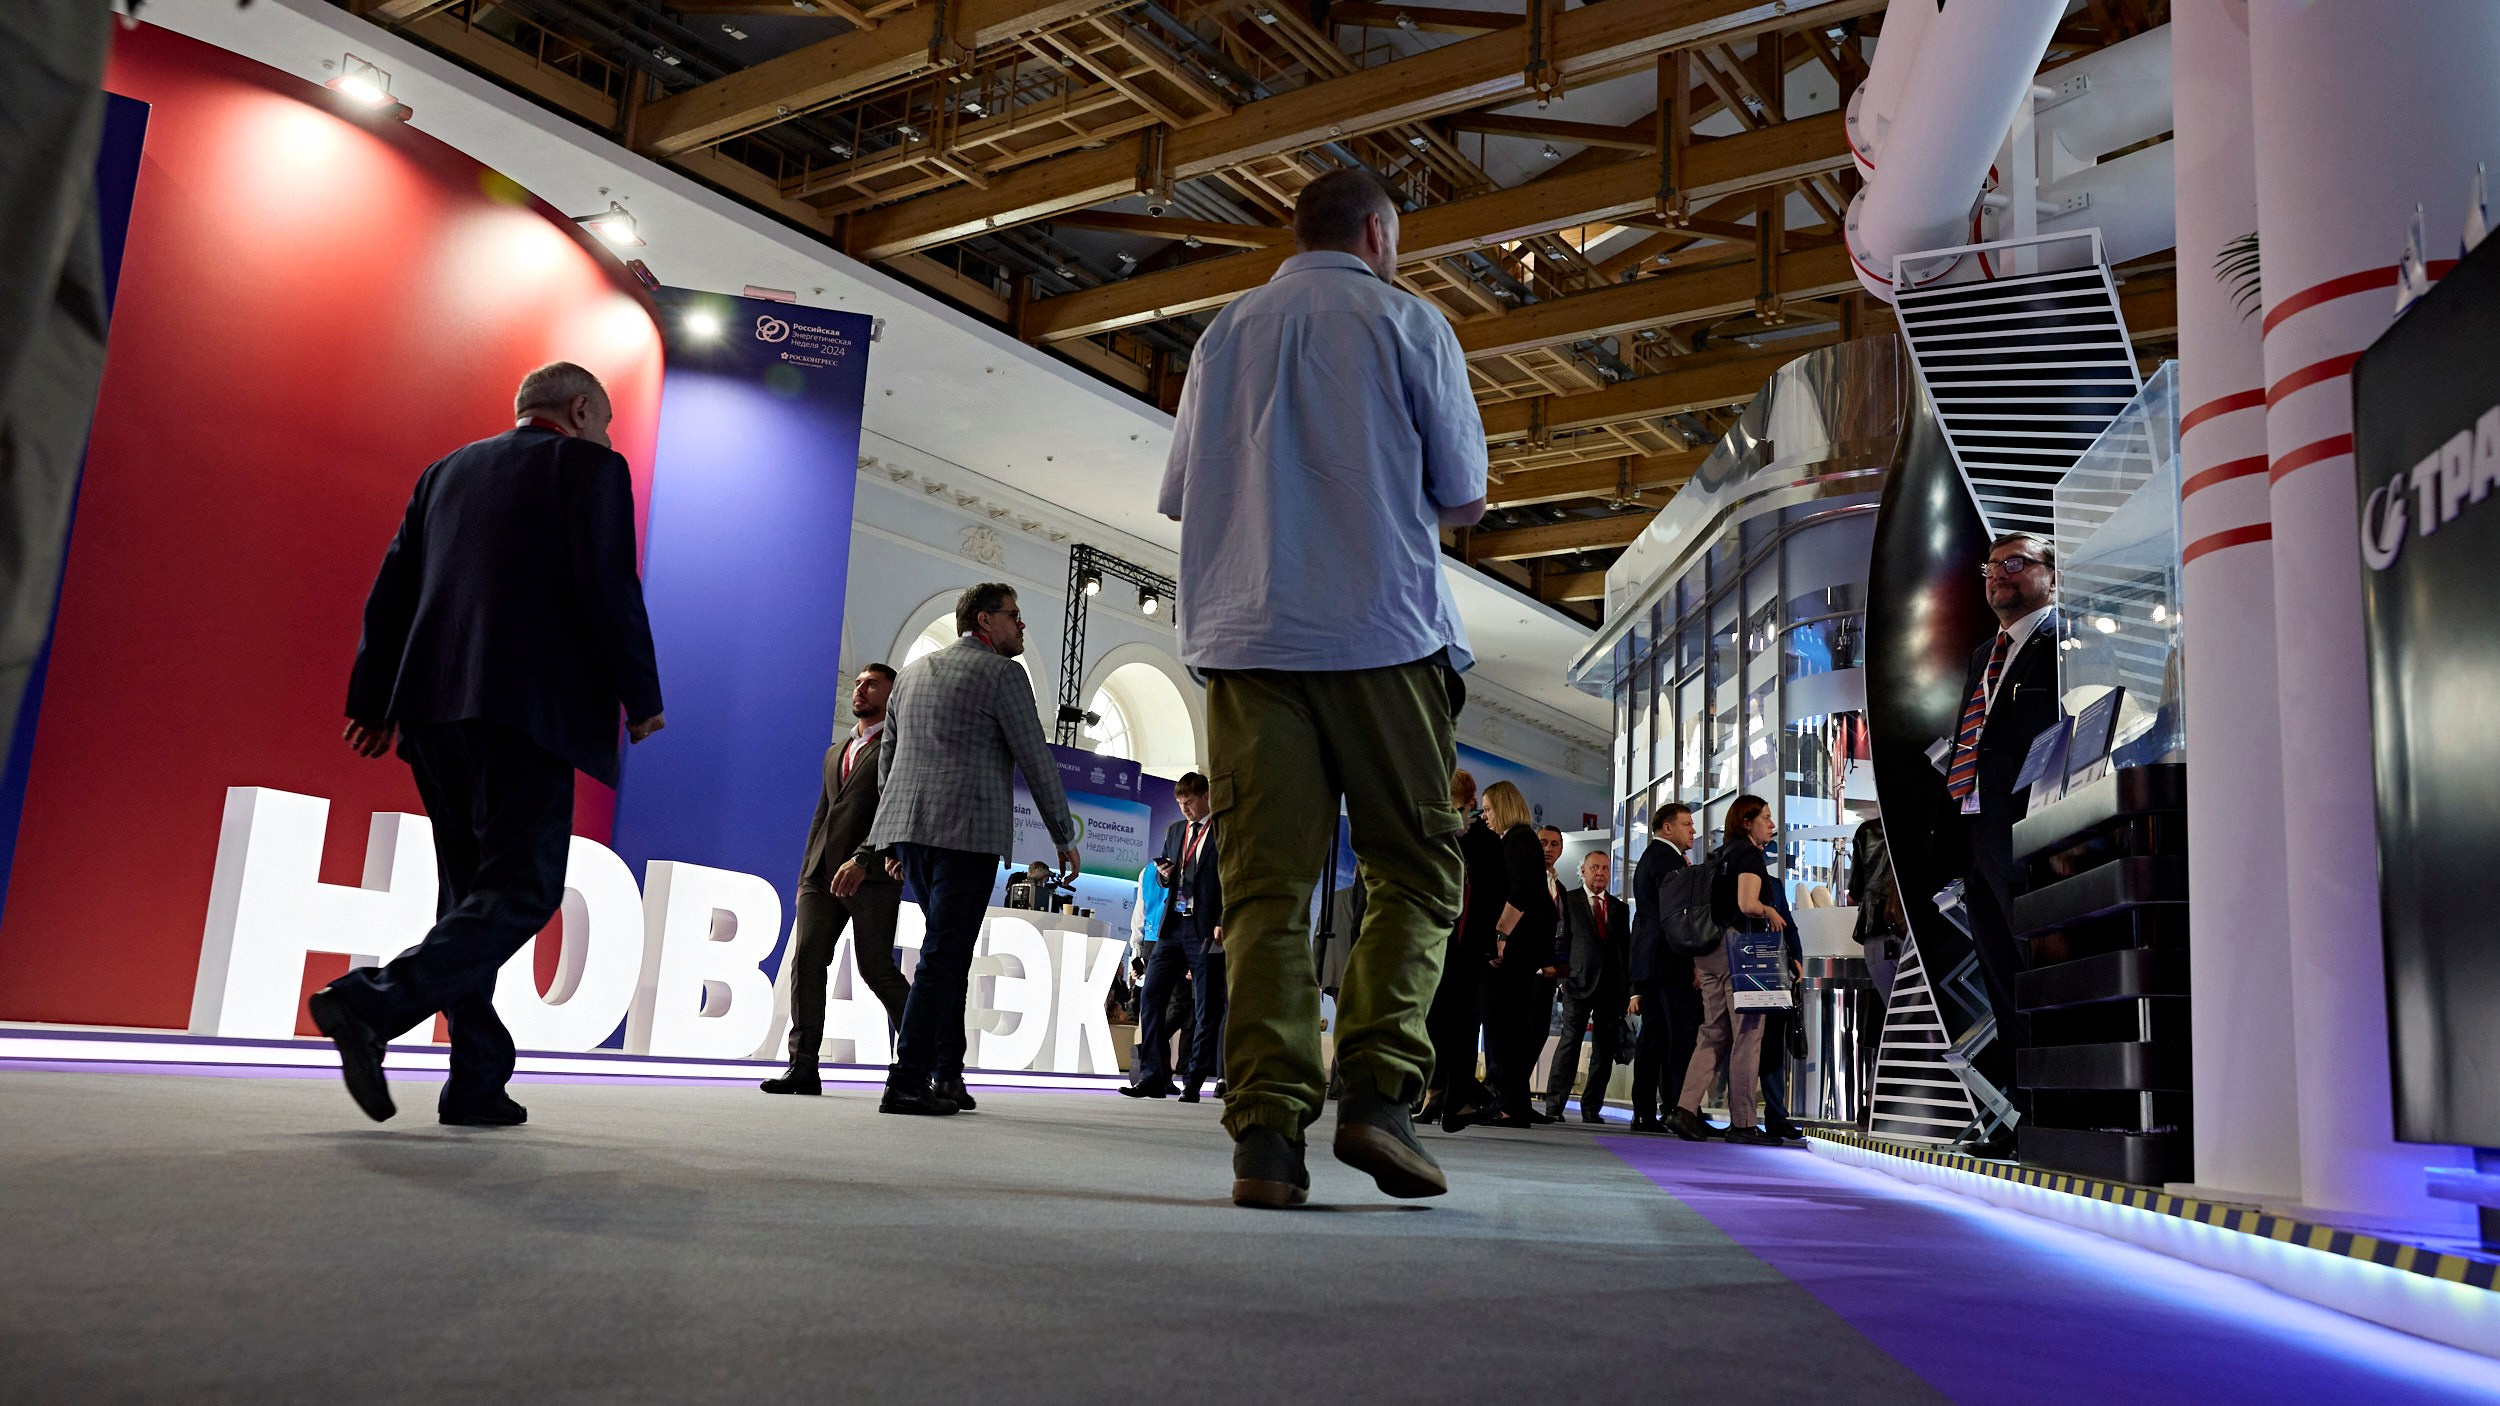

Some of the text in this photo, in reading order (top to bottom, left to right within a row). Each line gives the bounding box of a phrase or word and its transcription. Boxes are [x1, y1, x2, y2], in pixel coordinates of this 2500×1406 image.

[793, 323, 840, 336] Российская
[792, 331, 852, 346] Энергетическая
[791, 339, 845, 356] Неделя 2024
[789, 354, 839, 366] РОСКОНГРЕСС
[1056, 762, 1081, 772] ONGRESS
[1014, 804, 1031, 815] sian
[1088, 818, 1134, 833] Российская
[1087, 829, 1143, 847] Энергетическая
[1086, 841, 1139, 862] Неделя 2024
